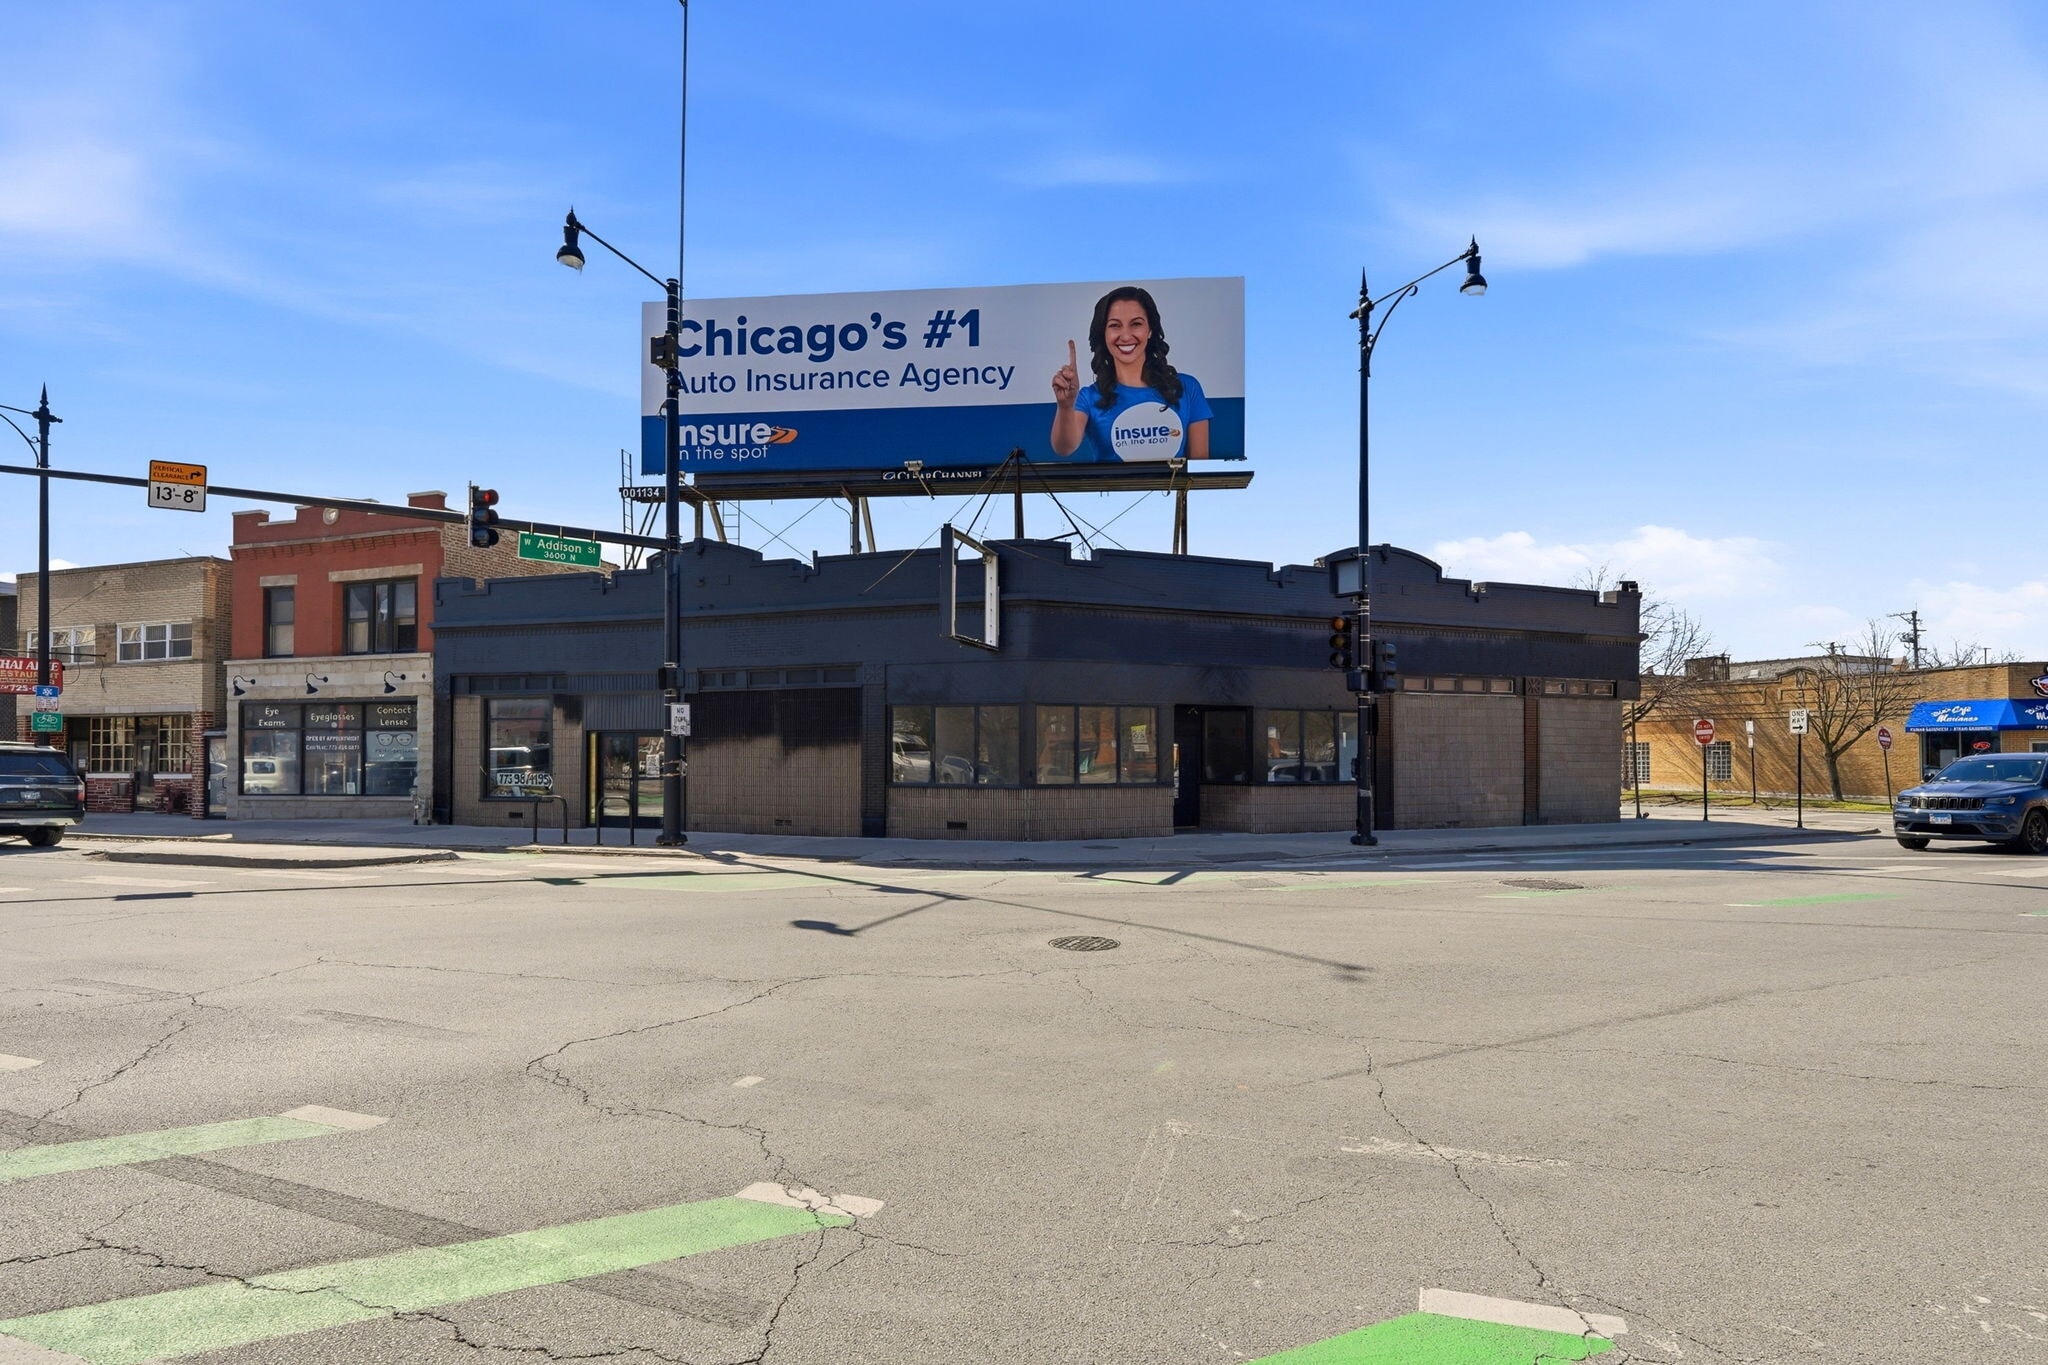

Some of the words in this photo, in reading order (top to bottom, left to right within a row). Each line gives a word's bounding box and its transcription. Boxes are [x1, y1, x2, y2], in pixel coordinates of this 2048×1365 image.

[677, 312, 908, 363] Chicago's
[922, 308, 980, 349] #1
[677, 370, 737, 394] Auto
[746, 368, 890, 392] Insurance
[899, 362, 1015, 392] Agency
[679, 422, 772, 446] nsure
[1114, 425, 1170, 441] insure
[679, 449, 690, 460] n
[695, 446, 725, 460] the
[730, 444, 769, 462] spot
[153, 465, 184, 473] VERTICAL
[153, 472, 190, 480] CLEARANCE
[622, 488, 660, 498] 001134
[524, 538, 532, 546] W
[537, 539, 582, 554] Addison
[587, 546, 596, 555] St
[543, 550, 566, 561] 3600
[569, 554, 576, 562] N
[0, 659, 23, 669] HAI
[25, 661, 59, 671] AE
[265, 707, 280, 716] Eye
[376, 706, 412, 715] Contact
[258, 719, 286, 727] Exams
[310, 712, 355, 723] Eyeglasses
[380, 719, 409, 727] Lenses
